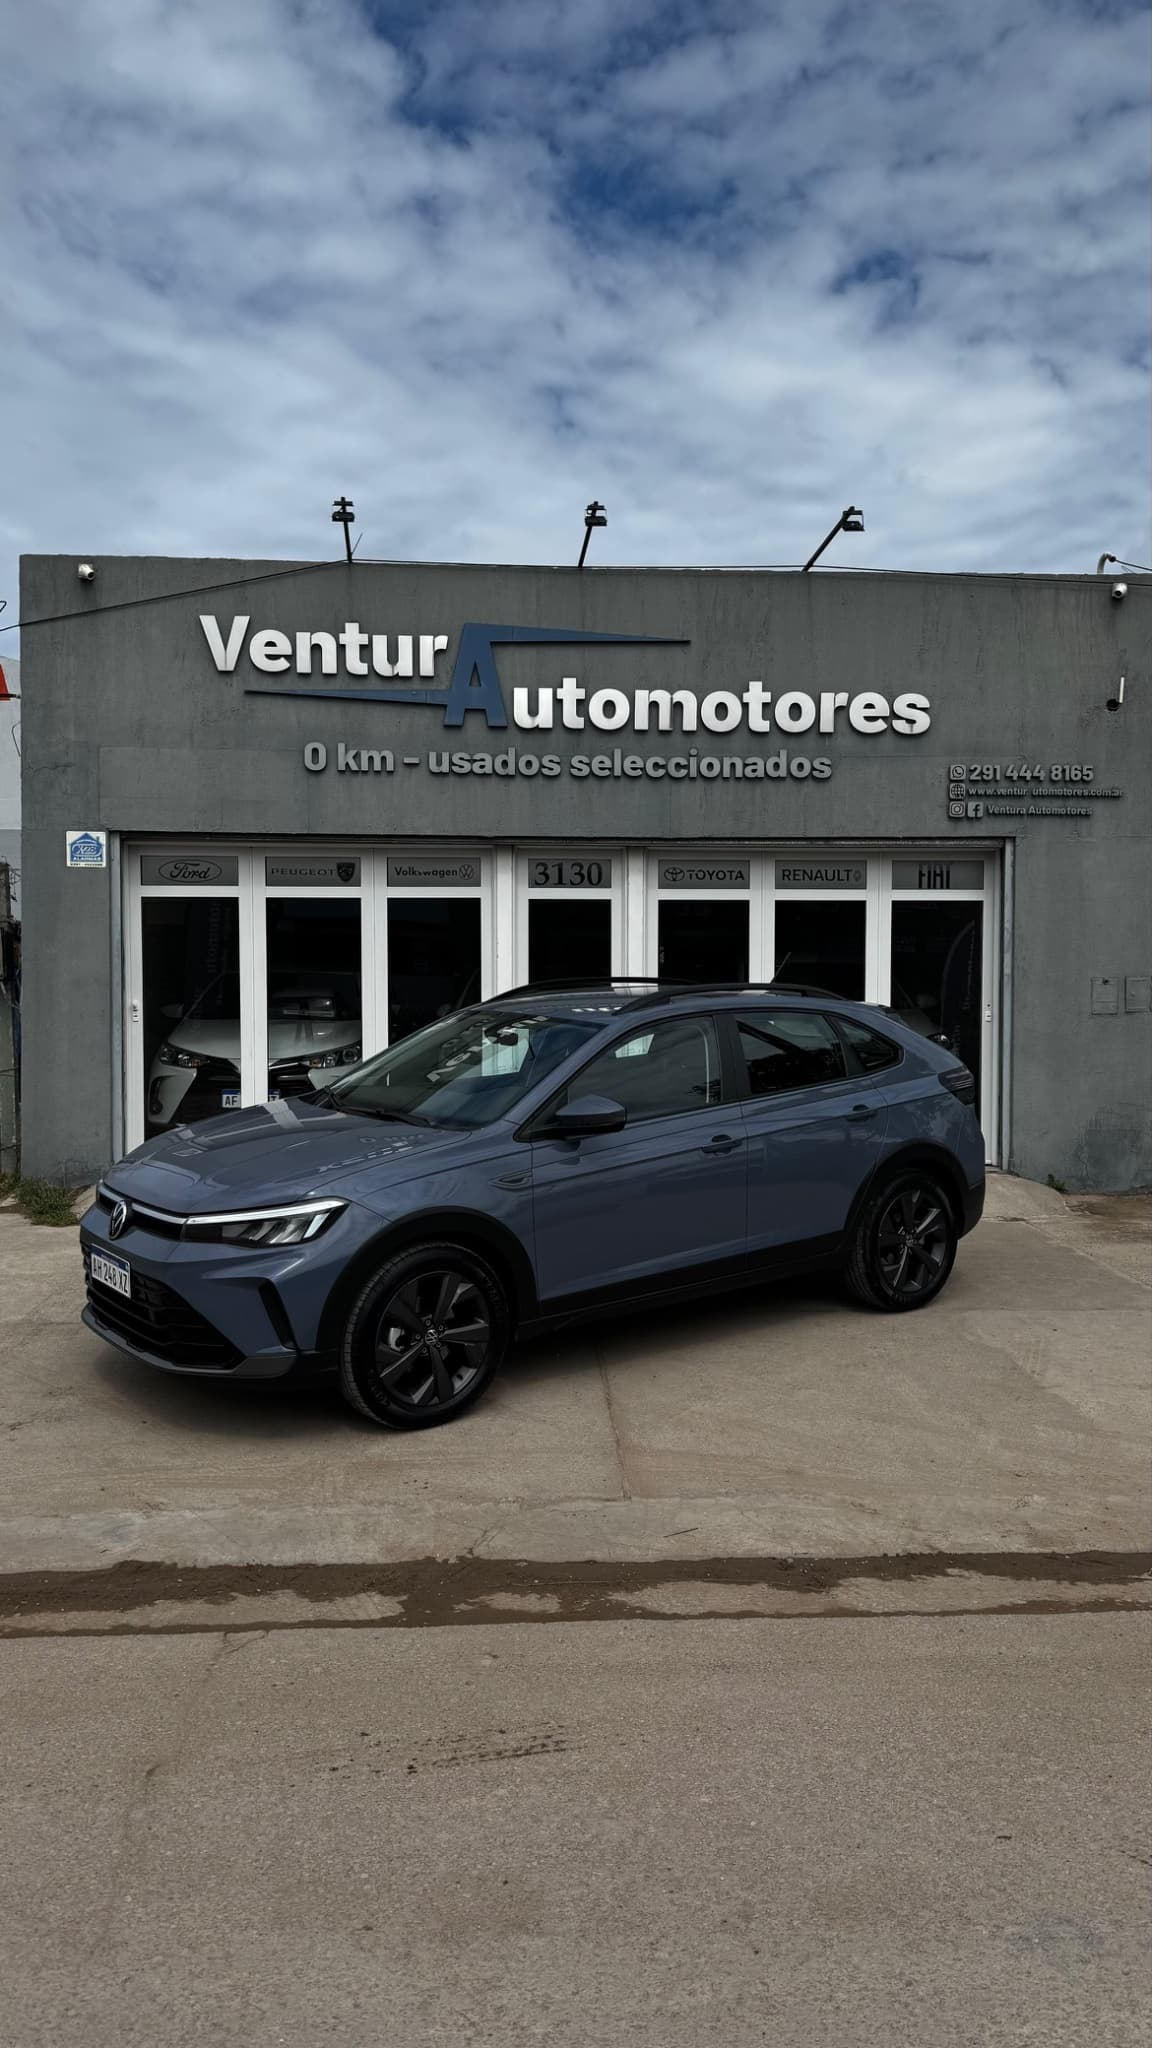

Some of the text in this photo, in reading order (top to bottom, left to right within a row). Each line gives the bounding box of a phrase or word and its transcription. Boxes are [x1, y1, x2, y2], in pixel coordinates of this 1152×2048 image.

[303, 741, 327, 772] 0
[337, 742, 394, 772] km
[428, 747, 561, 777] usados
[570, 748, 832, 779] seleccionados
[969, 764, 1094, 782] 291 444 8165
[987, 804, 1093, 817] Ventura Automotores
[169, 862, 211, 879] Ford
[270, 867, 336, 877] PEUGEOT
[394, 866, 458, 879] Volkswagen
[533, 861, 603, 887] 3130
[687, 869, 745, 881] TOYOTA
[781, 868, 852, 882] RENAULT
[92, 1256, 103, 1279] AH
[103, 1262, 117, 1286] 248
[118, 1269, 129, 1293] XZ
